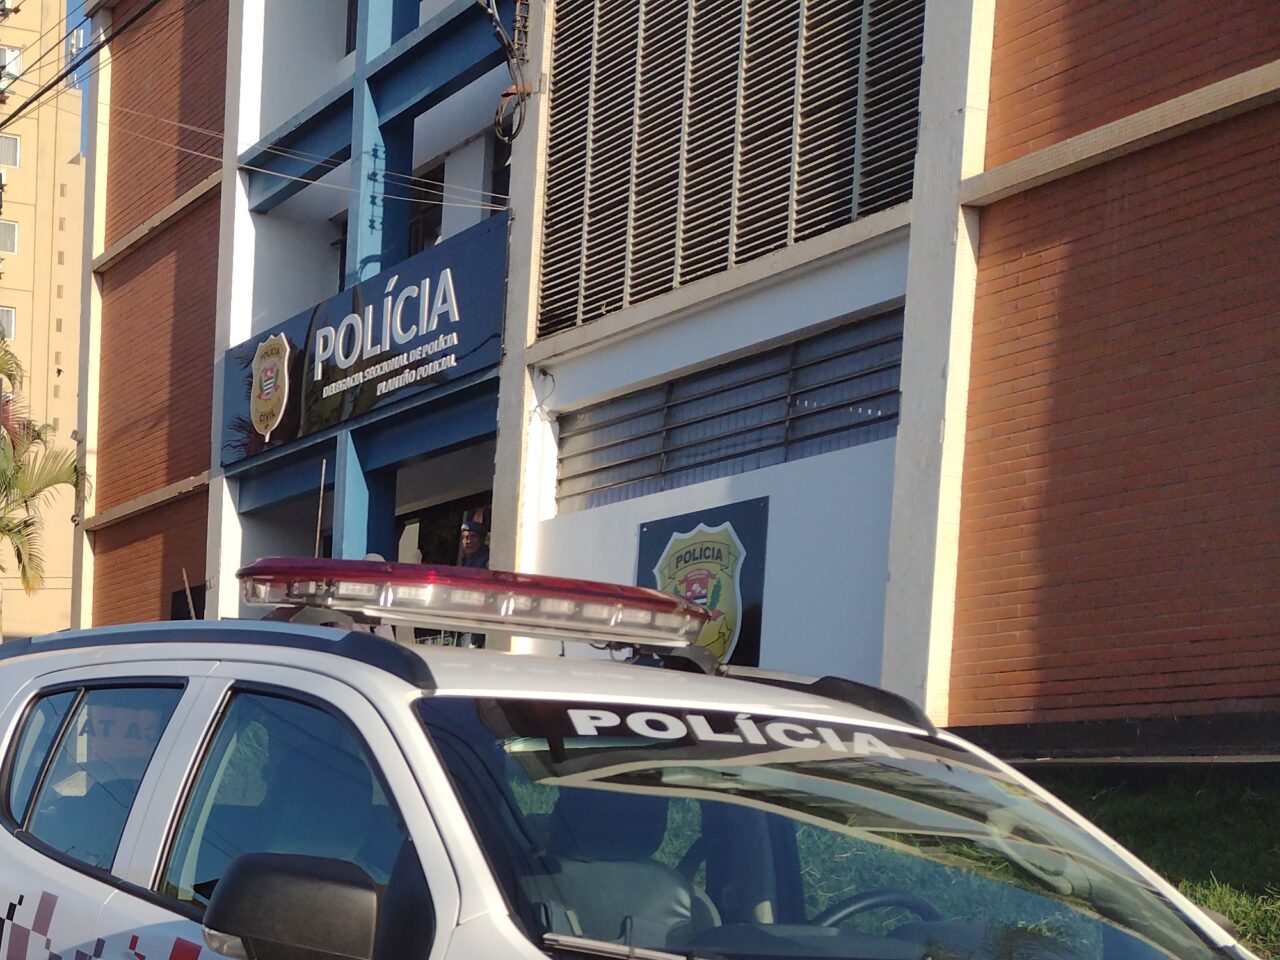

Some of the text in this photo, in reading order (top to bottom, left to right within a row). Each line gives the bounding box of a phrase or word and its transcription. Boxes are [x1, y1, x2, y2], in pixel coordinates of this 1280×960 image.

[314, 268, 460, 380] POLÍCIA
[323, 332, 459, 398] DELEGACIA SECCIONAL DE POLÍCIA
[377, 354, 457, 396] PLANTÃO POLICIAL
[259, 411, 275, 423] CIVIL
[675, 543, 724, 568] POLÍCIA
[566, 708, 905, 760] POLÍCIA
